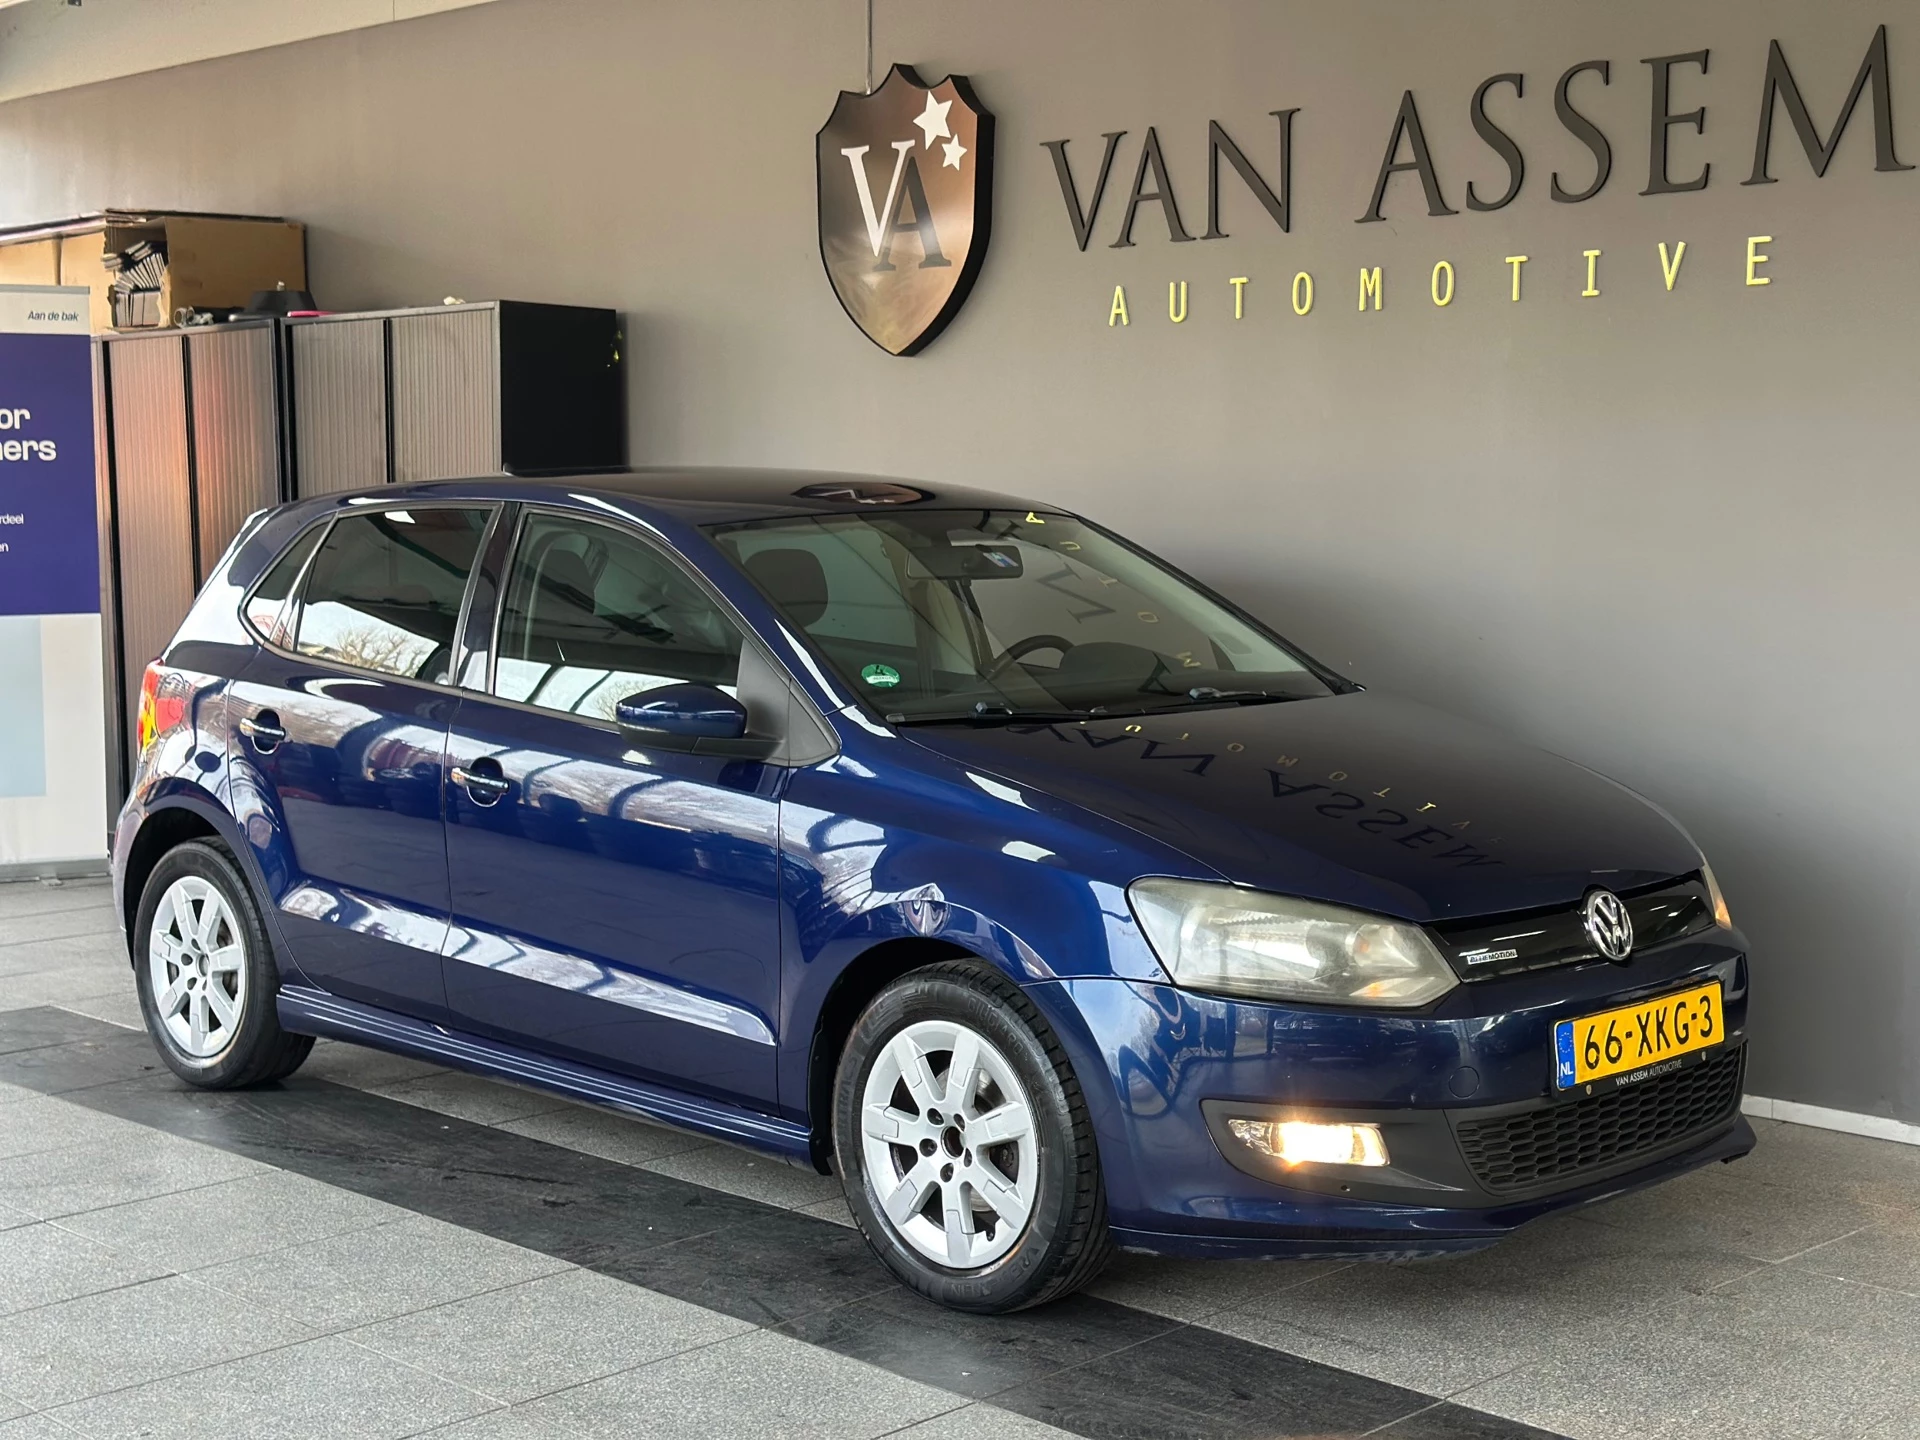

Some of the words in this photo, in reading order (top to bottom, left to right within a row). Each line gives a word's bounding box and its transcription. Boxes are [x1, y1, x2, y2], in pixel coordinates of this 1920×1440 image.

[1040, 108, 1302, 252] VAN
[1354, 24, 1916, 223] ASSEM
[841, 139, 952, 271] VA
[1108, 235, 1773, 327] AUTOMOTIVE
[28, 310, 46, 320] Aan
[48, 311, 60, 321] de
[61, 311, 79, 321] bak
[0, 439, 57, 462] ers
[1584, 995, 1713, 1070] 66-XKG-3
[1560, 1061, 1574, 1076] NL
[1615, 1074, 1629, 1087] VAN
[1630, 1069, 1648, 1083] ASSEM
[1649, 1059, 1682, 1077] AUTOMOTIVE
